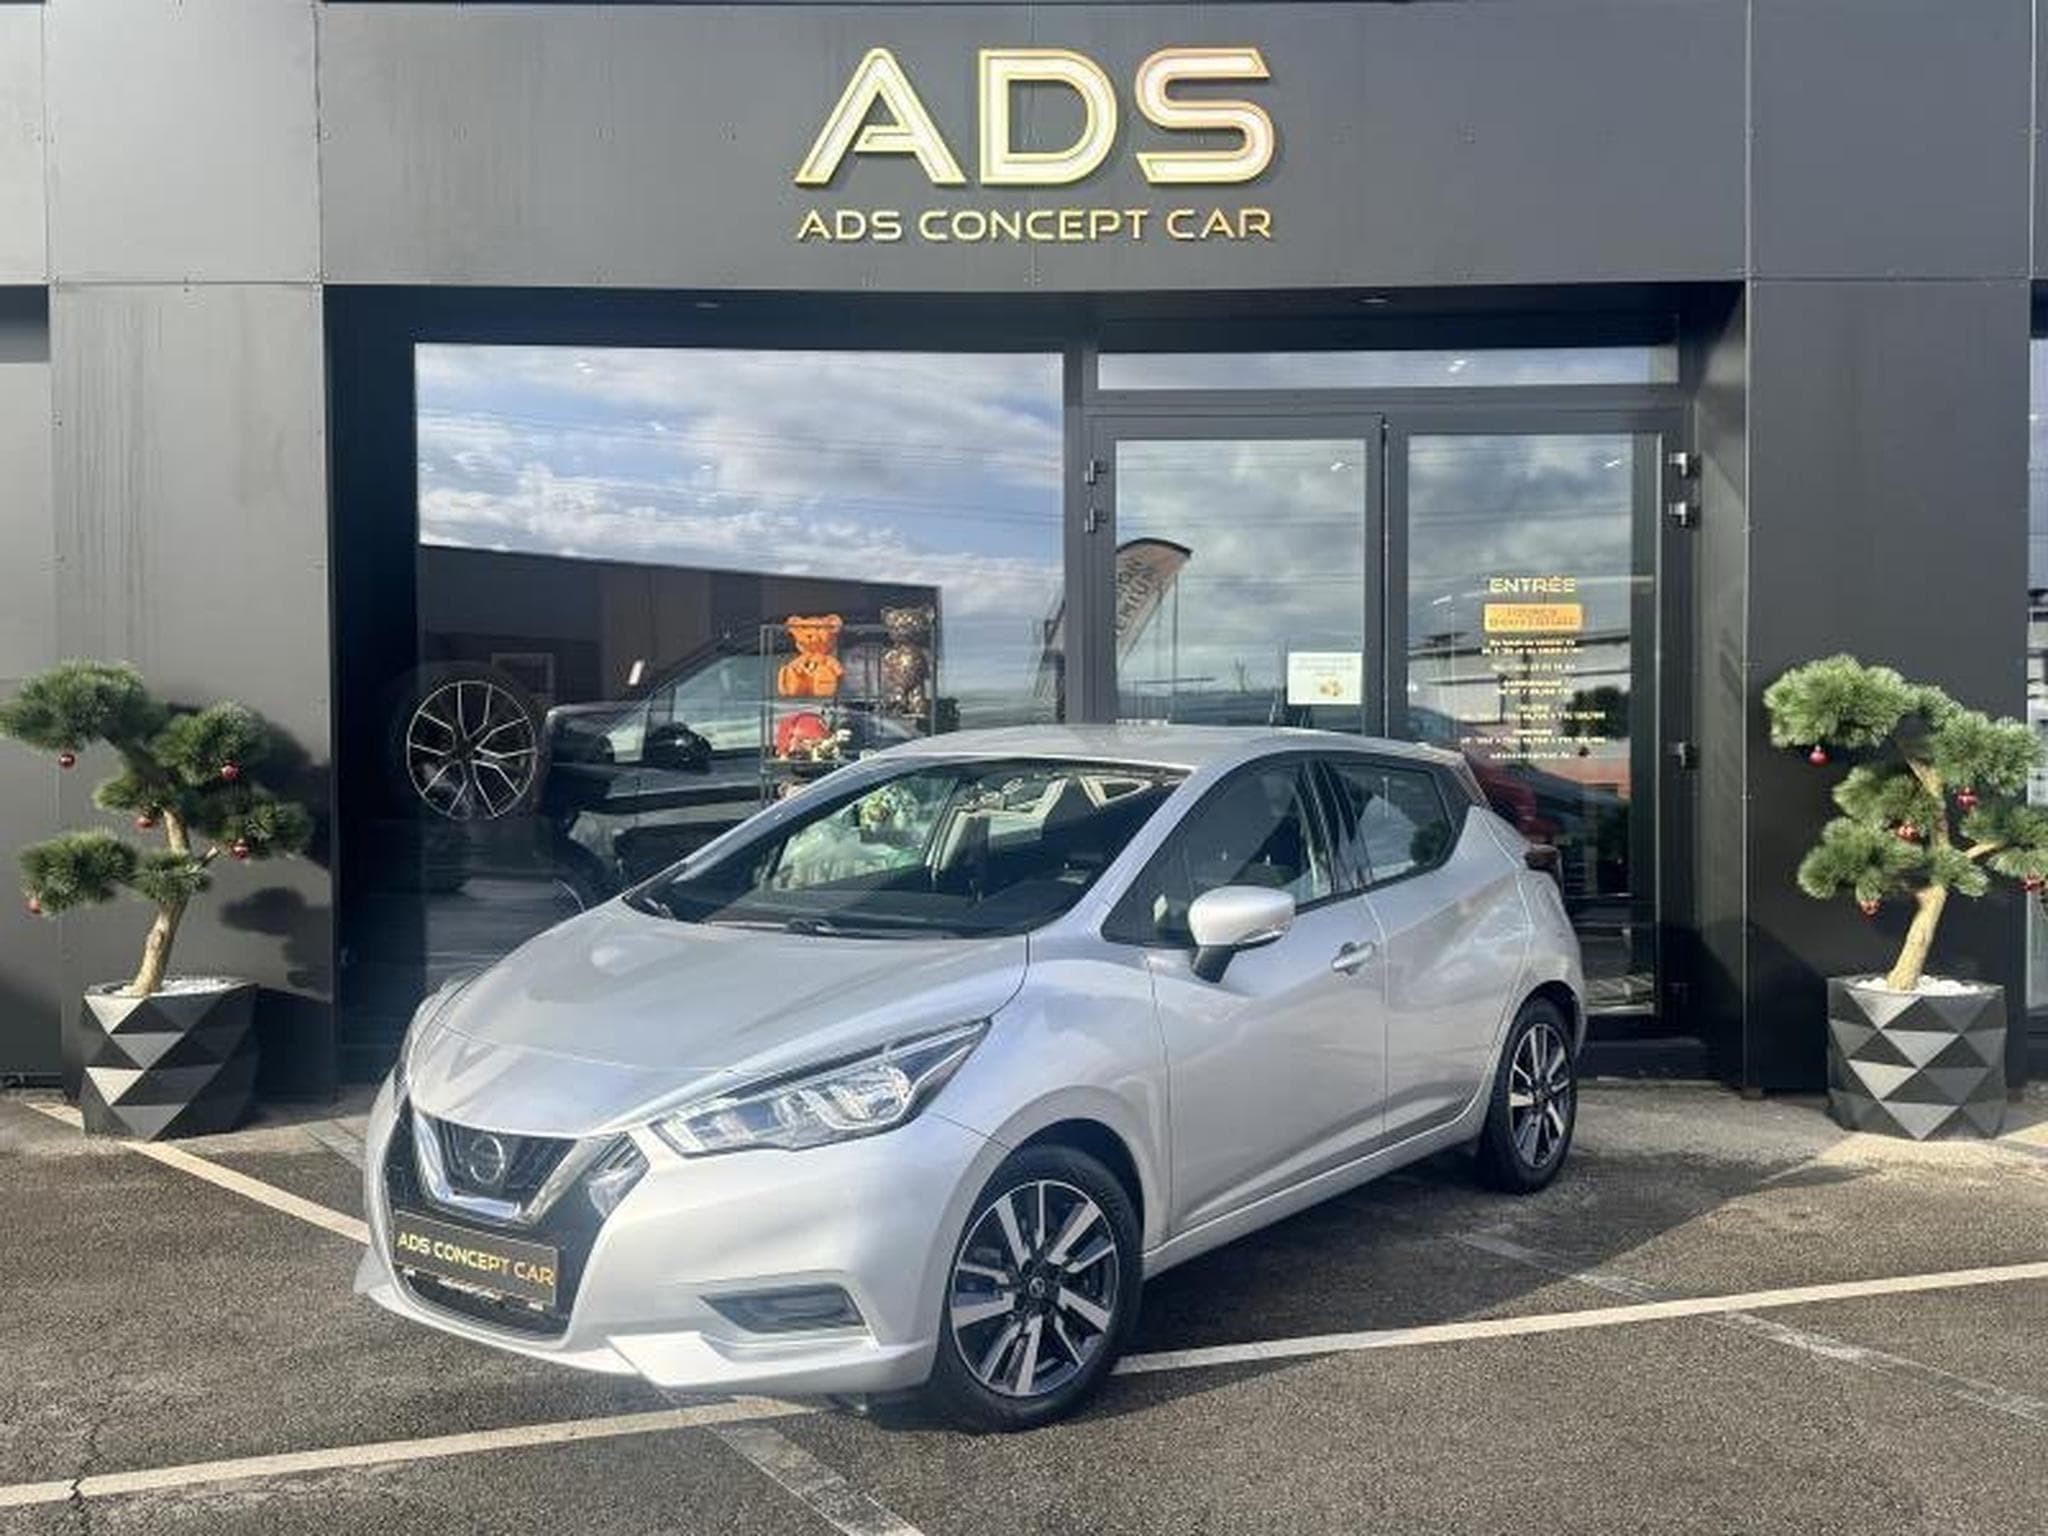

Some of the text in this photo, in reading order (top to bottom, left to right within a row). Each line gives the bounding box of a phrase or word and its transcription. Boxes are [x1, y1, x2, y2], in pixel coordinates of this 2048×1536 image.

[794, 47, 1275, 185] ADS
[797, 207, 1272, 242] ADS CONCEPT CAR
[397, 1232, 555, 1286] ADS CONCEPT CAR
